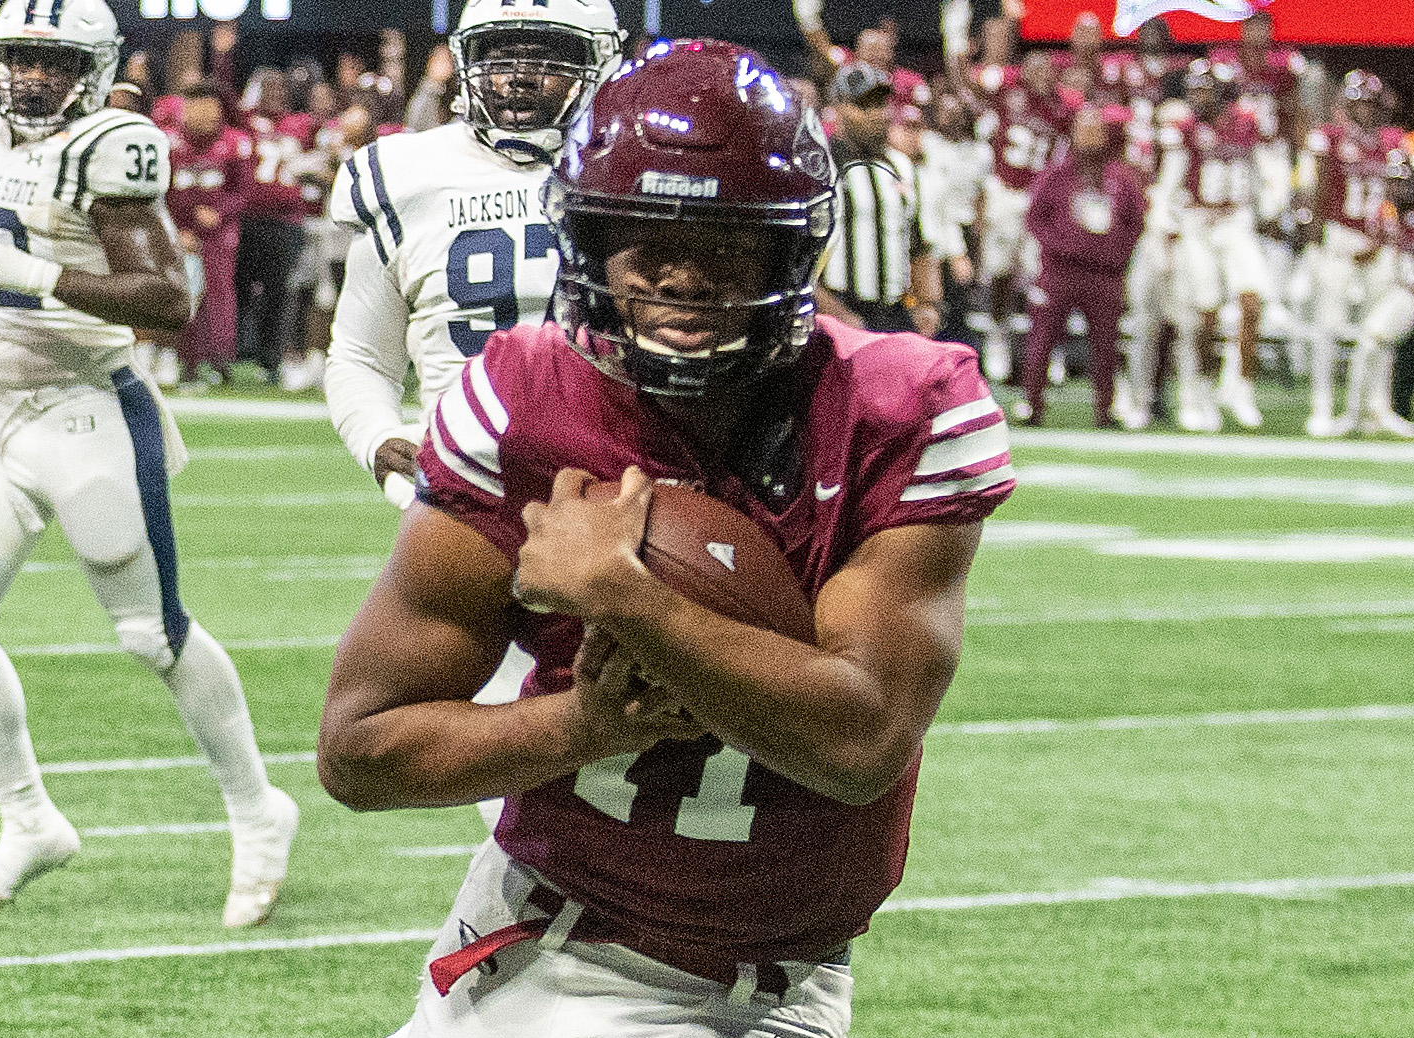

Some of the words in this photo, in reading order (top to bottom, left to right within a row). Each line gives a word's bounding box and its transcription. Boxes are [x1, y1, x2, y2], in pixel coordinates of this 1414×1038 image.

[125, 143, 158, 181] 32
[641, 170, 719, 198] Riddell
[448, 188, 529, 229] JACKSON
